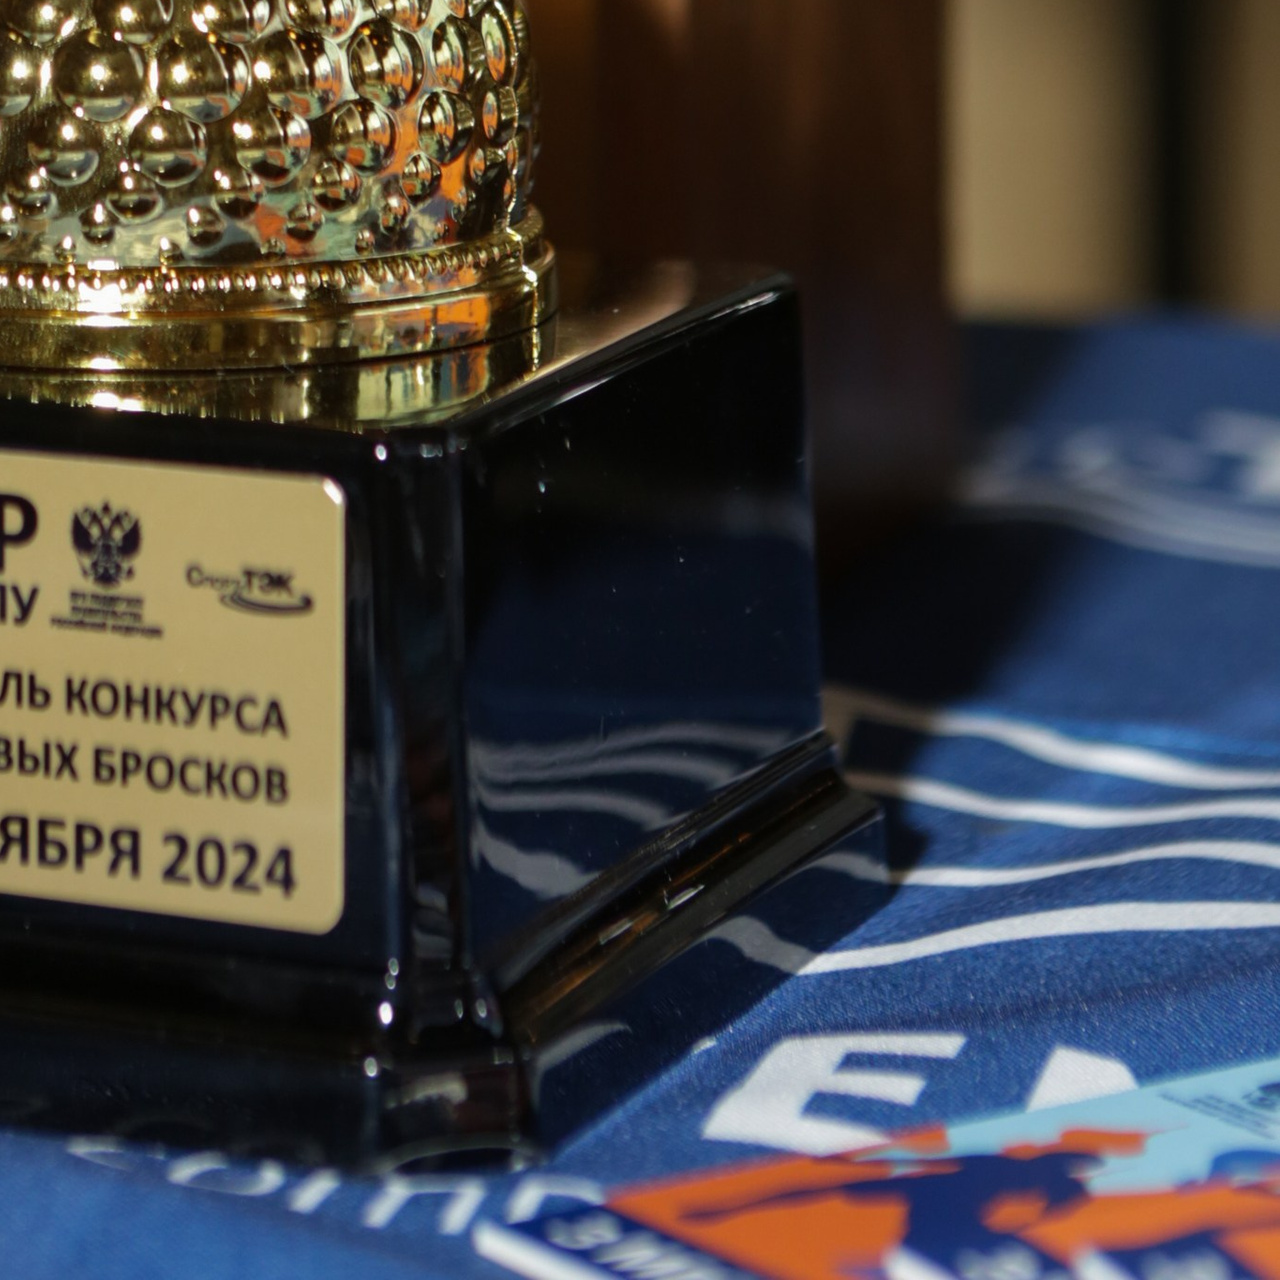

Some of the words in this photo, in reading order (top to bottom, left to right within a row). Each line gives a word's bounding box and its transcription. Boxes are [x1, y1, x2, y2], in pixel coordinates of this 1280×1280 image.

[66, 676, 291, 739] КОНКУРСА
[93, 745, 291, 805] БРОСКОВ
[161, 833, 299, 900] 2024
